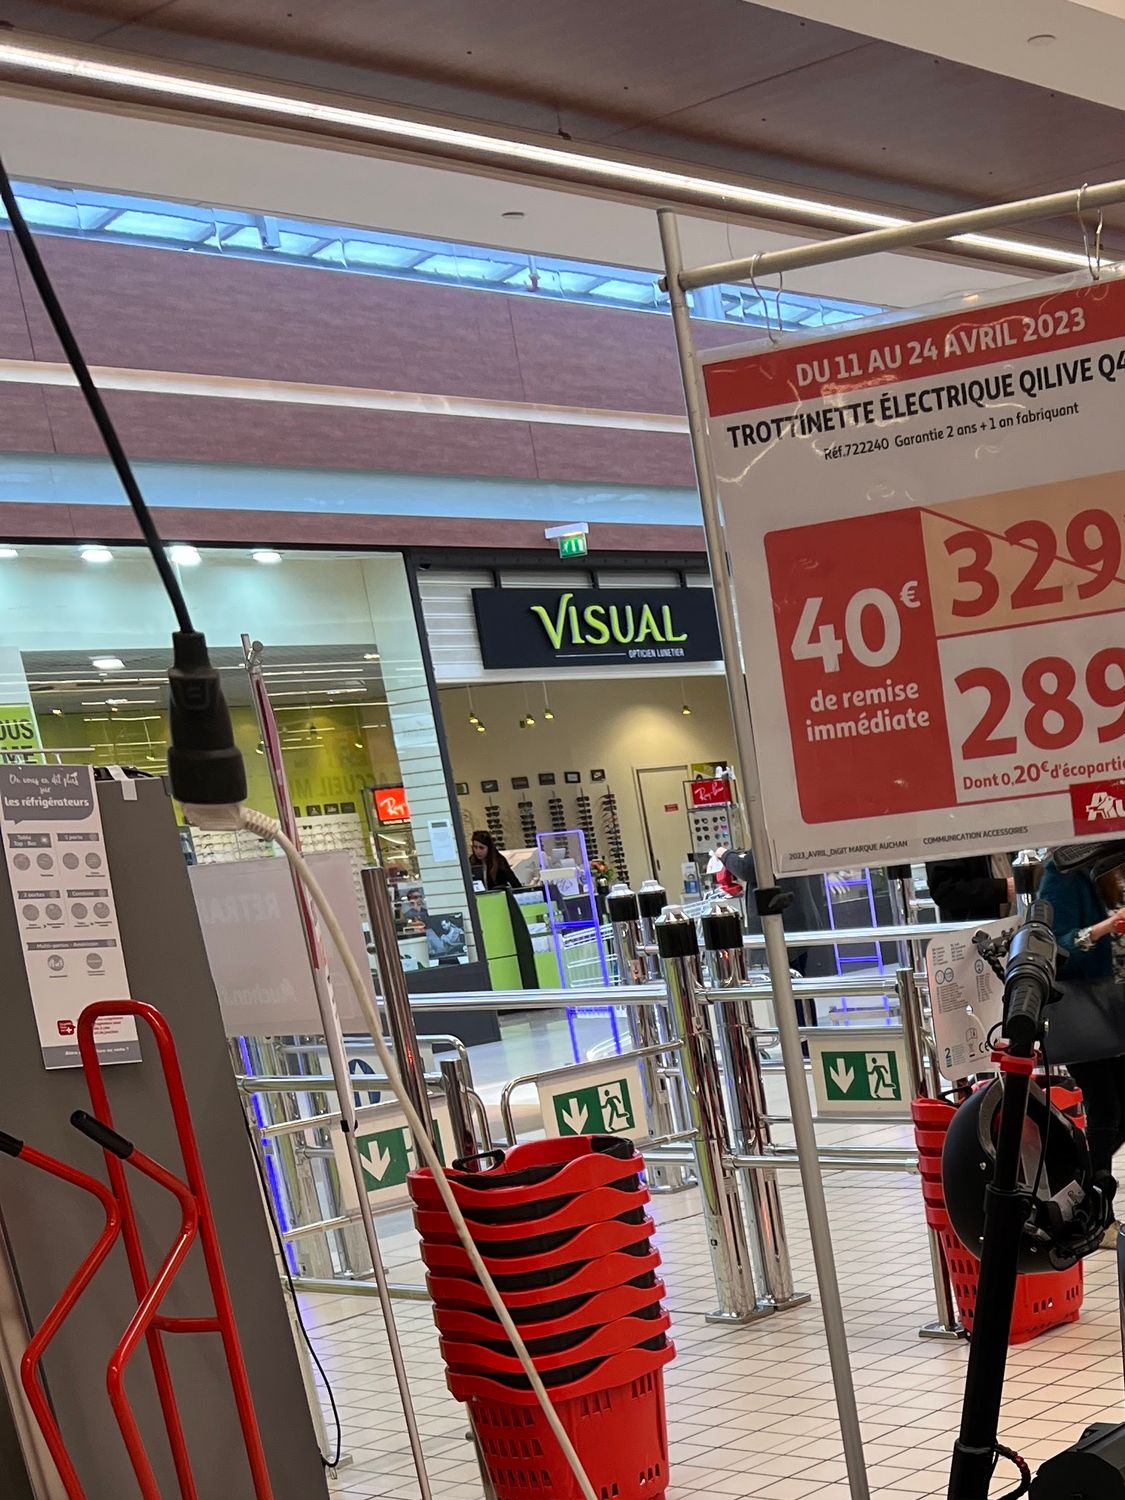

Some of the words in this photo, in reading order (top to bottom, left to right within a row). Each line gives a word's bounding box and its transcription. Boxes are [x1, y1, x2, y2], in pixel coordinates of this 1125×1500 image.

[796, 360, 831, 387] DU
[835, 354, 863, 379] 11
[868, 345, 902, 373] AU
[909, 338, 938, 366] 24
[944, 321, 1017, 358] AVRIL
[1022, 307, 1086, 342] 2023
[727, 400, 875, 448] TROTTINETTE
[881, 374, 1015, 422] ÉLECTRIQUE
[1019, 358, 1094, 398] QILIVE
[824, 438, 889, 461] Réf.722240
[895, 426, 944, 447] Garantie
[946, 425, 954, 438] 2
[957, 420, 977, 436] ans
[999, 413, 1014, 428] an
[1016, 403, 1079, 427] fabriquant
[530, 593, 688, 649] VISUAL
[628, 649, 656, 659] OPTICIEN
[656, 648, 685, 658] LUNETIER
[809, 688, 838, 713] de
[842, 678, 919, 709] remise
[805, 709, 930, 742] immédiate
[962, 773, 1000, 791] Dont
[849, 843, 878, 856] MARQUE
[878, 839, 908, 853] AUCHAN
[923, 830, 983, 845] COMMUNICATION
[983, 826, 1028, 839] ACCESSOIRES
